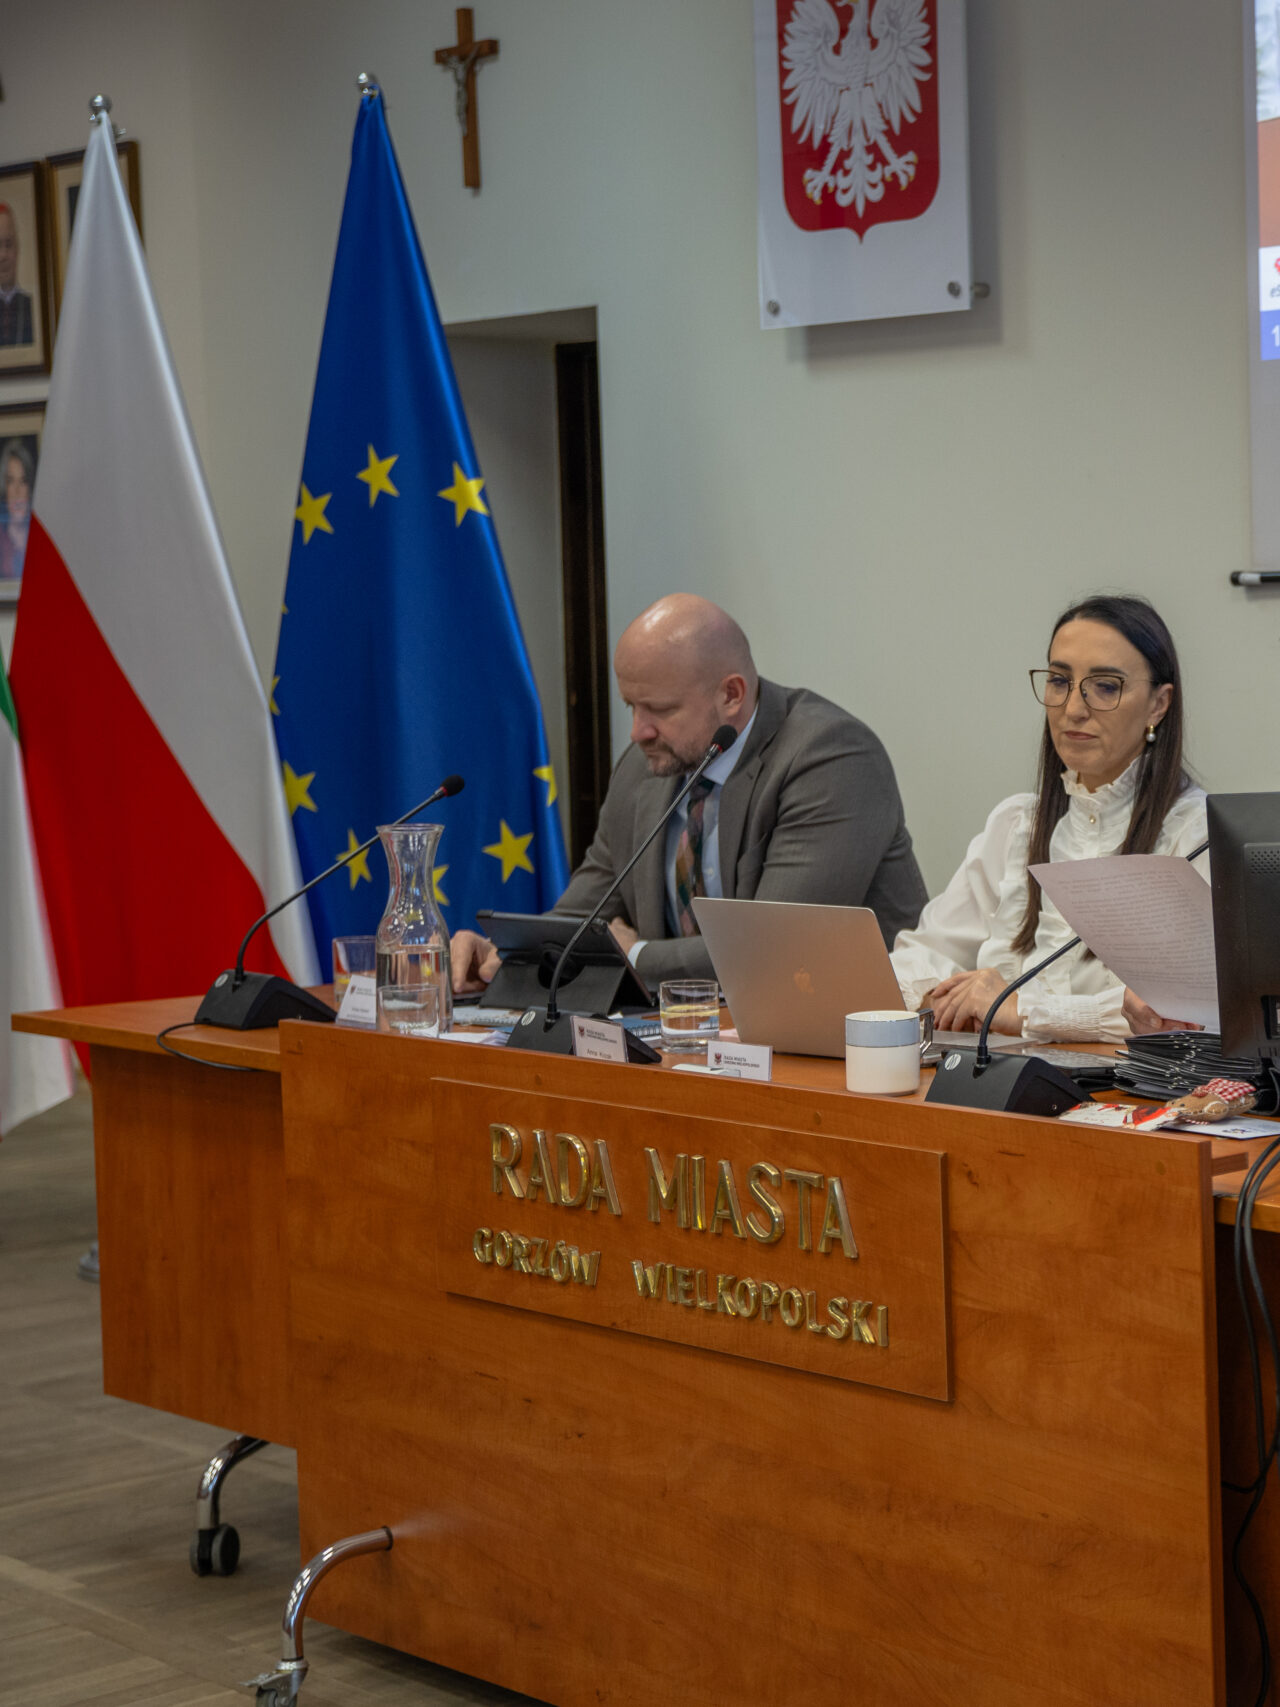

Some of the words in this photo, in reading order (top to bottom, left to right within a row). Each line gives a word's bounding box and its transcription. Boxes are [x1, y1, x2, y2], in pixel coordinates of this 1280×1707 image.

[489, 1122, 622, 1216] RADA
[643, 1147, 859, 1259] MIASTA
[472, 1227, 601, 1287] GORZÓW
[631, 1259, 889, 1348] WIELKOPOLSKI
